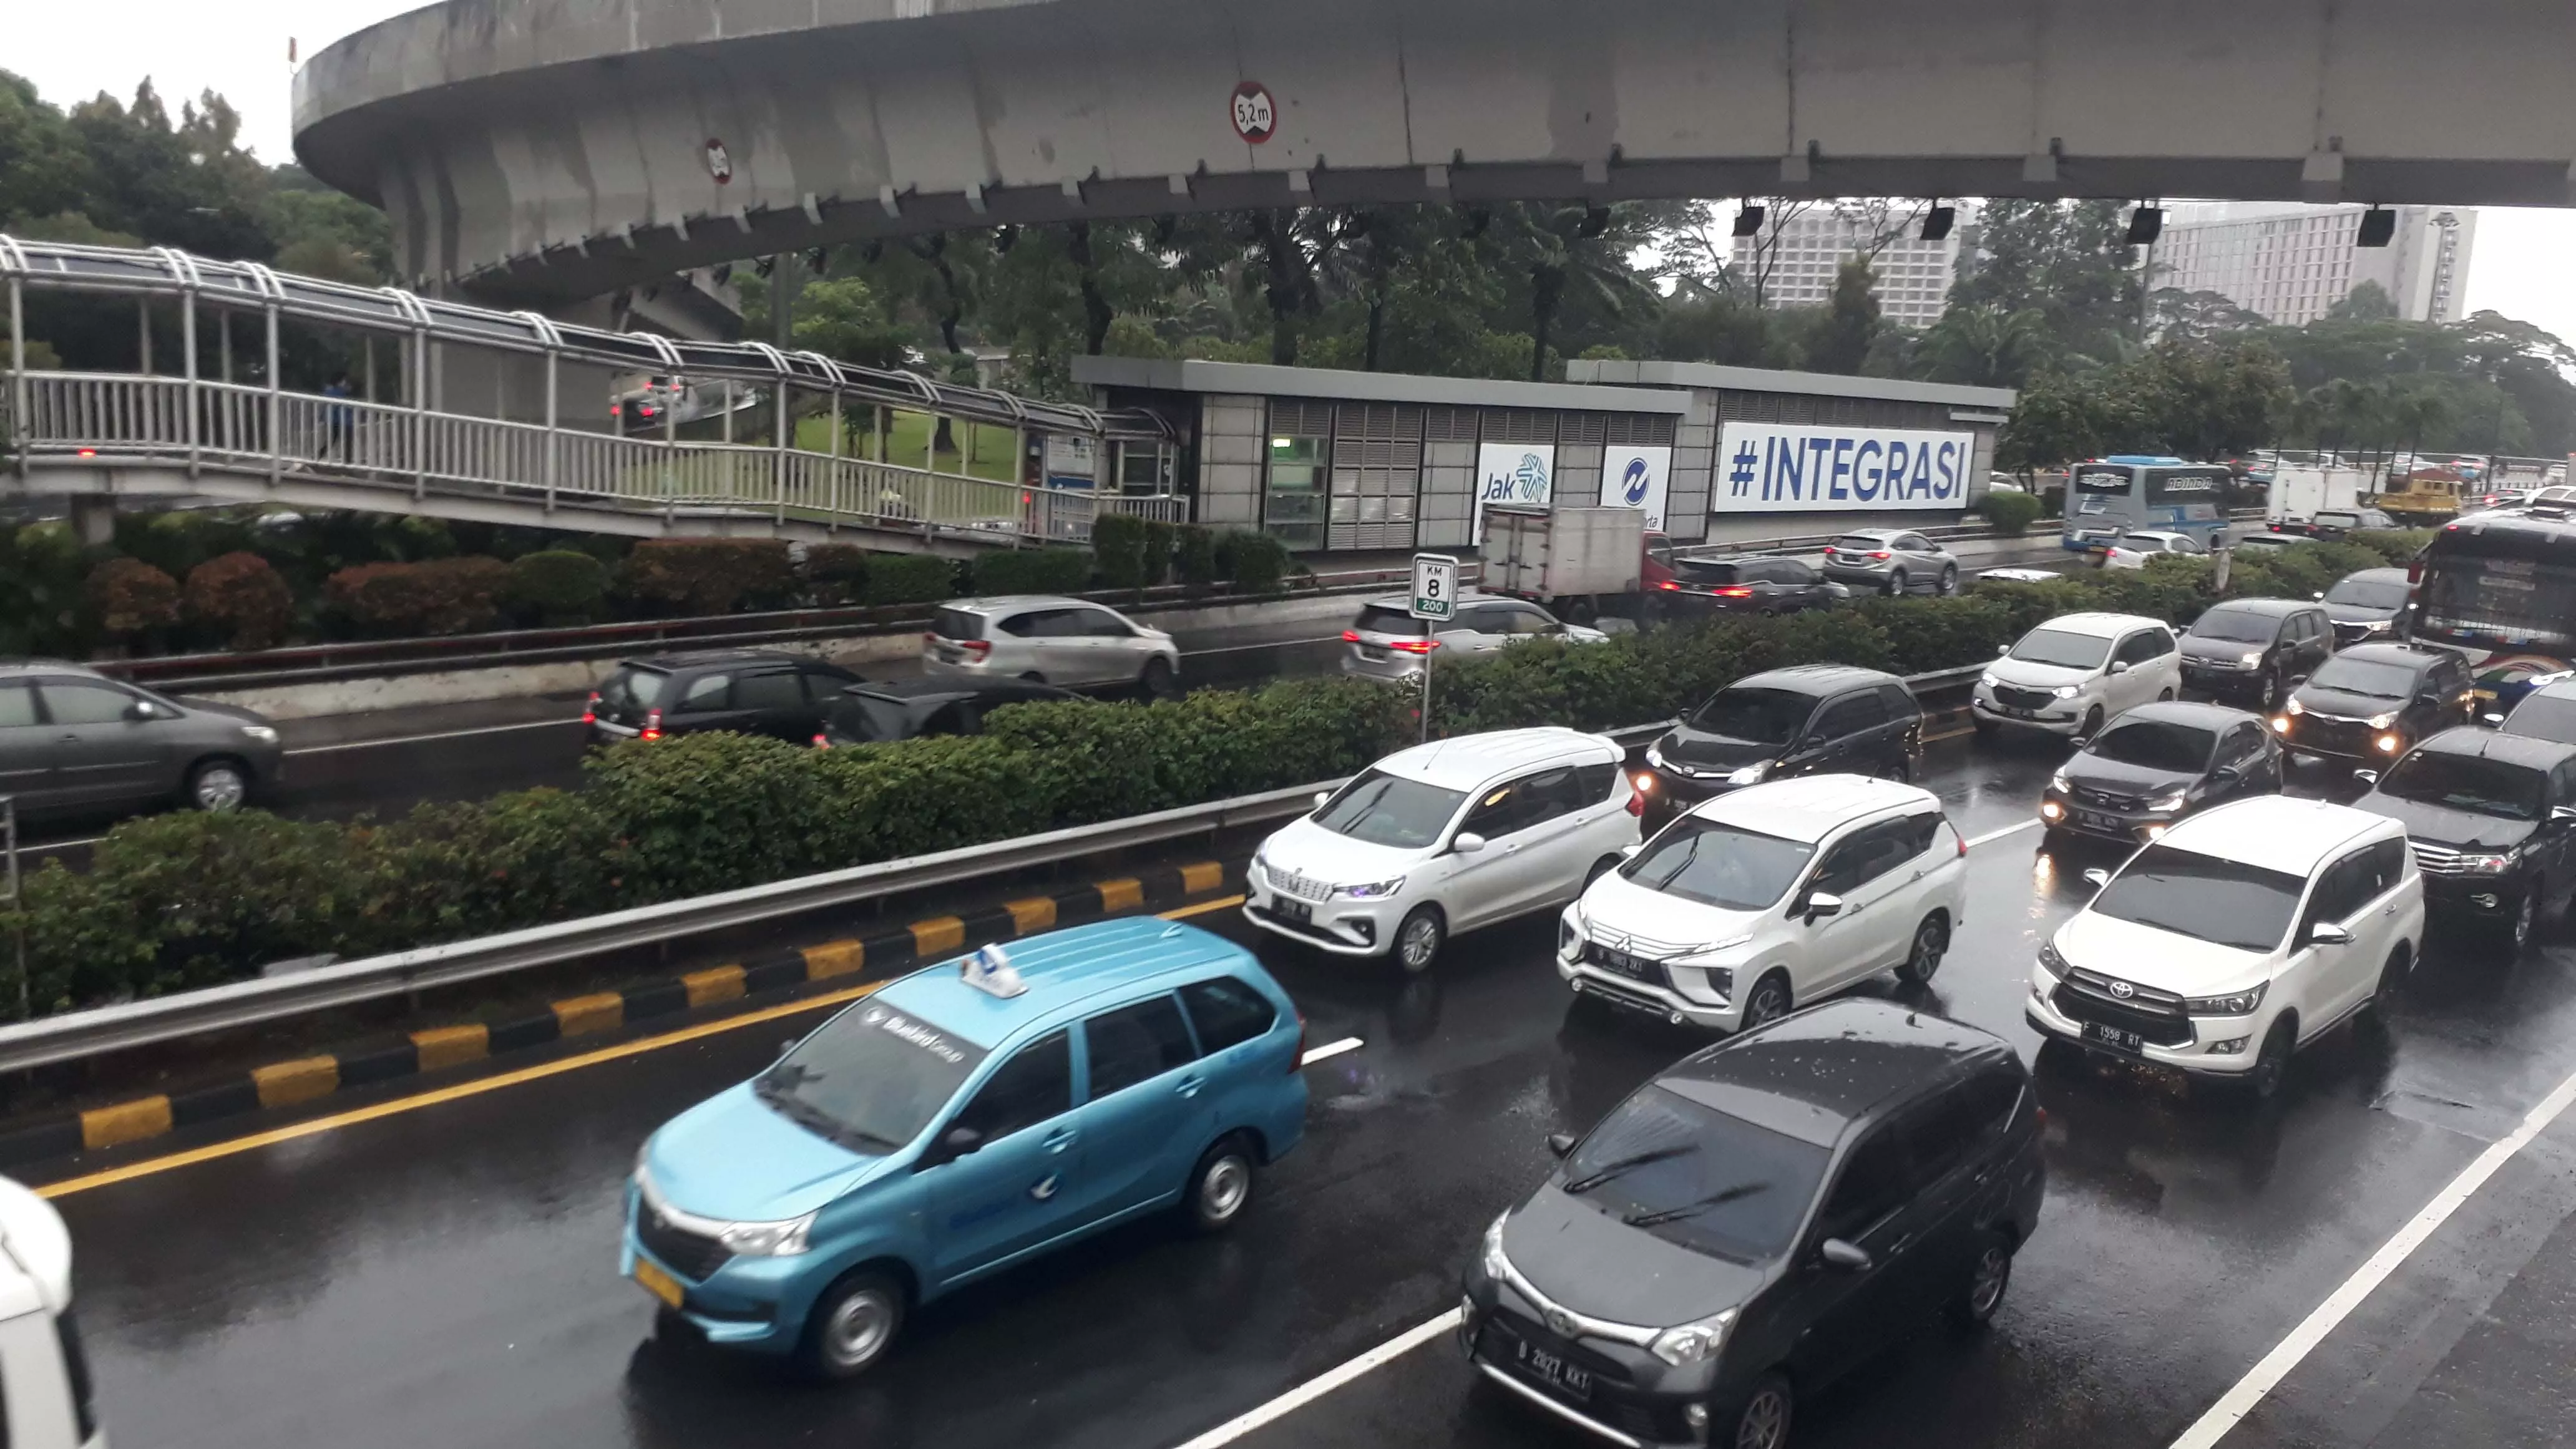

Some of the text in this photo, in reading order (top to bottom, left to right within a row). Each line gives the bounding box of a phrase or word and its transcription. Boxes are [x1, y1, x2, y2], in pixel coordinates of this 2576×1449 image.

[1729, 436, 1966, 502] #INTEGRASI
[1481, 472, 1516, 500] Jak
[1427, 566, 1443, 577] KM
[1428, 579, 1440, 598] 8
[1422, 600, 1443, 613] 200
[2084, 1022, 2090, 1032] F
[2100, 1025, 2121, 1042] 1558
[2128, 1033, 2140, 1047] RT
